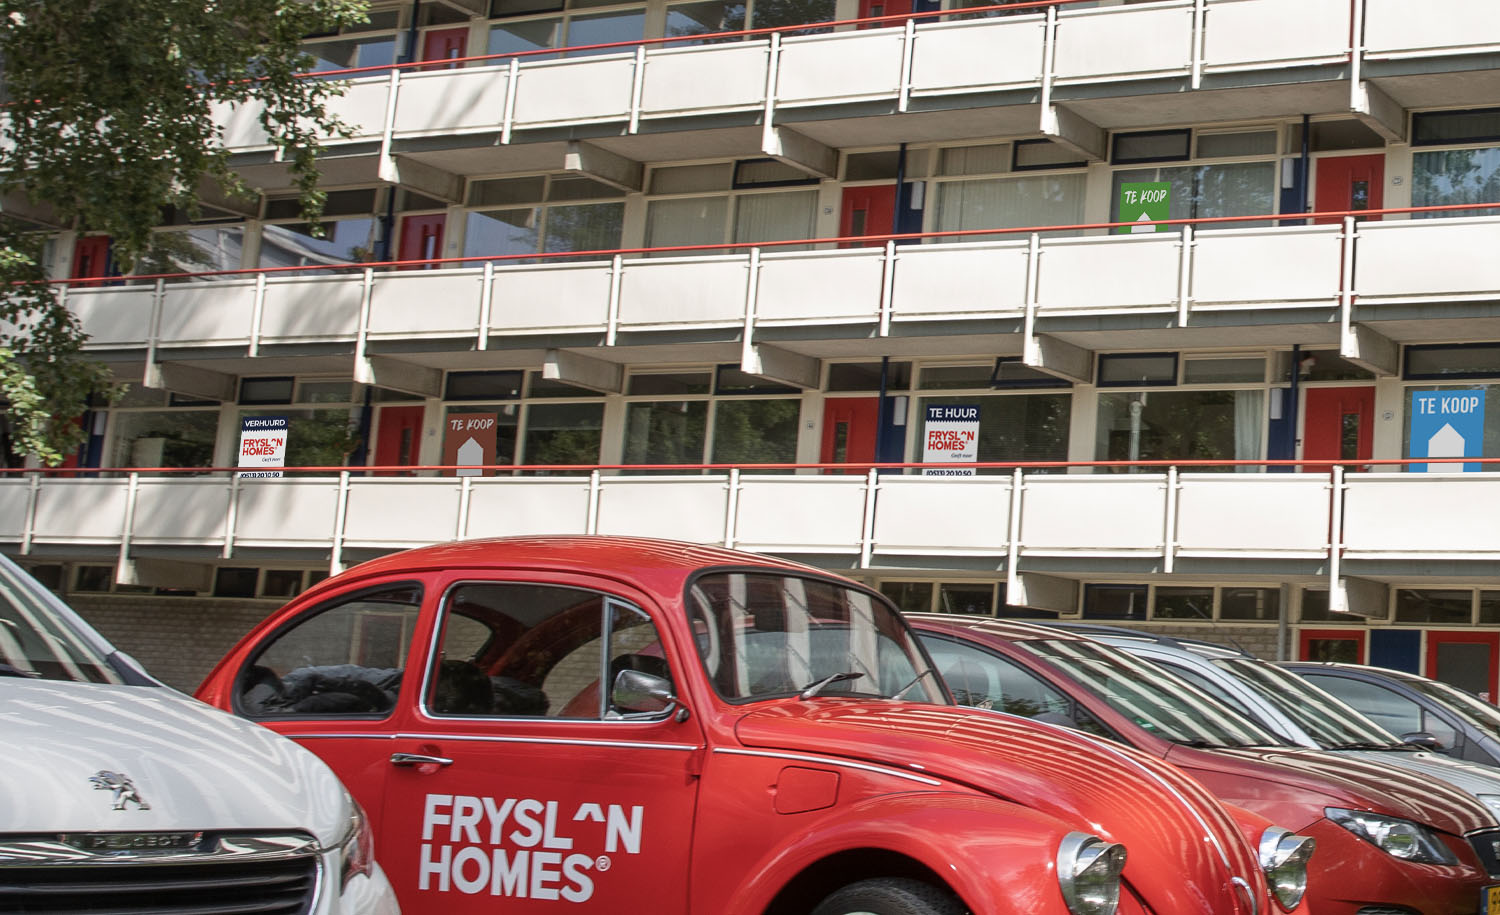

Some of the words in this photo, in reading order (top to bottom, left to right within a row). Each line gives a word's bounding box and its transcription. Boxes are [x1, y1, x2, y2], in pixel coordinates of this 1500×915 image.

[1125, 190, 1137, 204] TE
[1140, 190, 1167, 204] KOOP
[1418, 398, 1436, 414] TE
[1441, 396, 1479, 414] KOOP
[929, 408, 943, 418] TE
[945, 408, 977, 418] HUUR
[245, 419, 286, 427] VERHUURD
[450, 419, 464, 431] TE
[466, 419, 494, 431] KOOP
